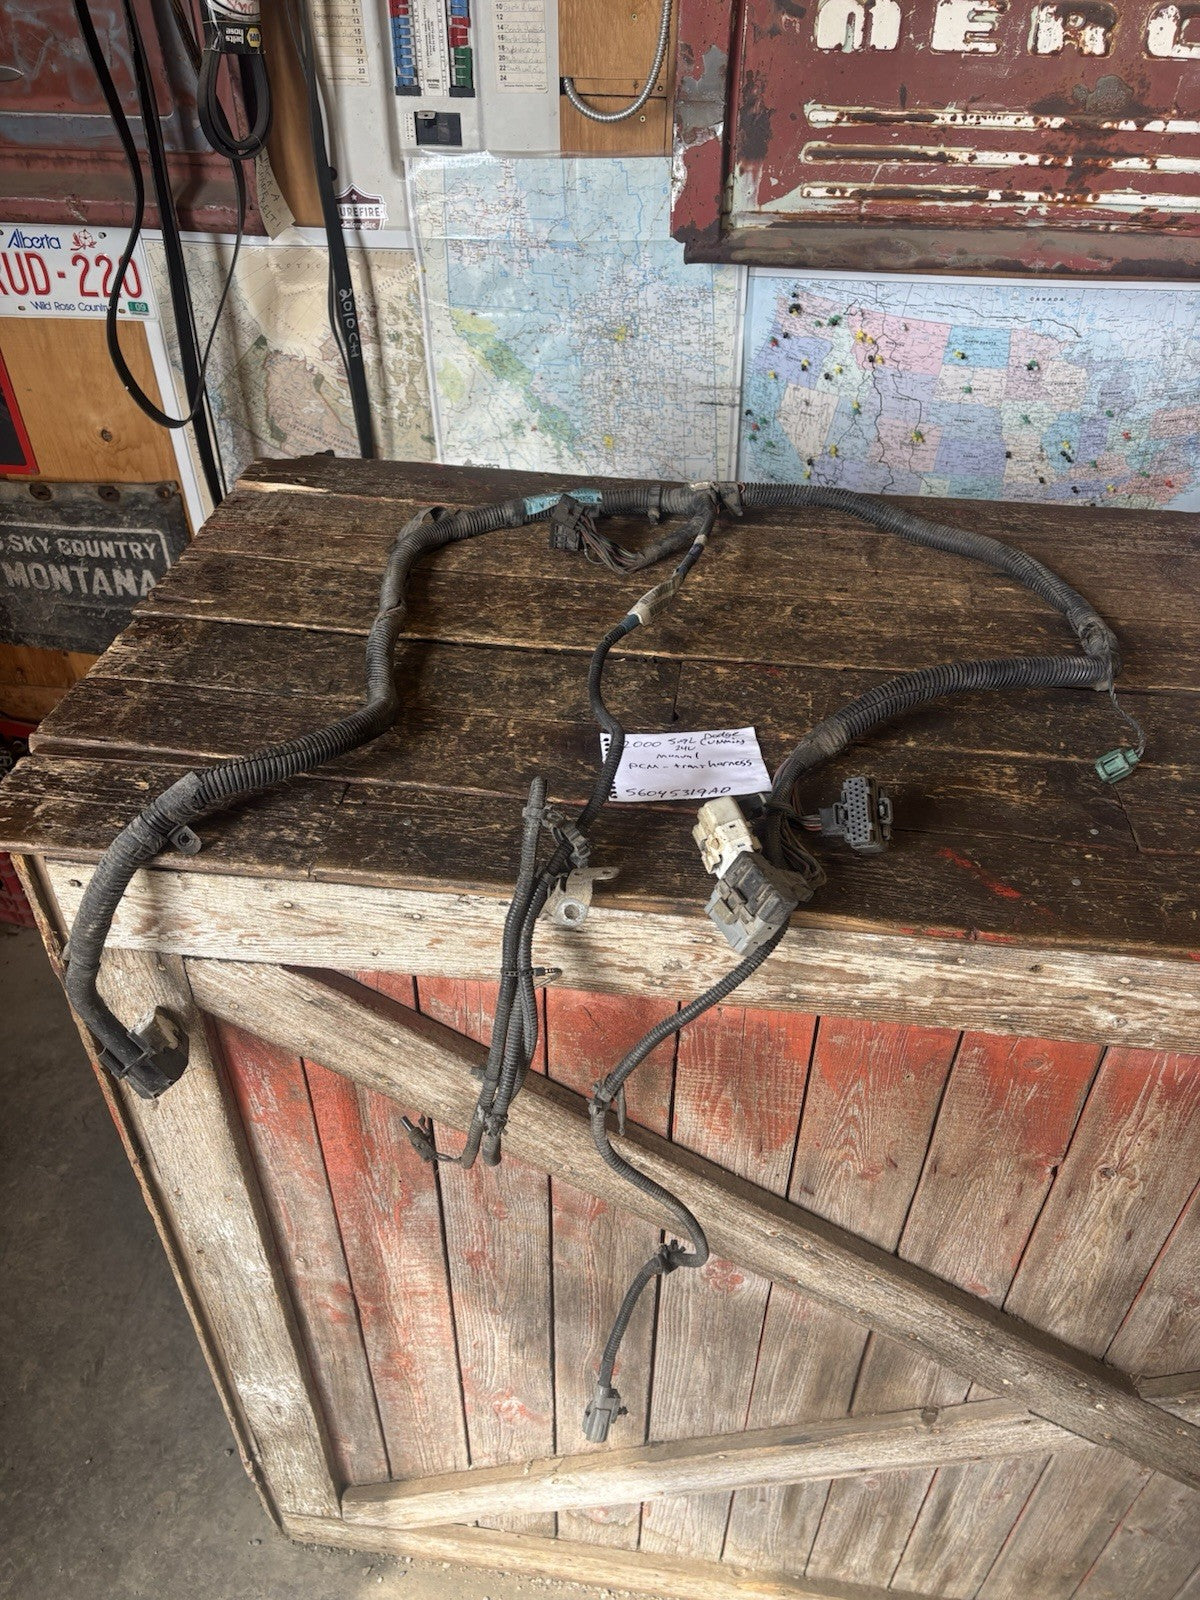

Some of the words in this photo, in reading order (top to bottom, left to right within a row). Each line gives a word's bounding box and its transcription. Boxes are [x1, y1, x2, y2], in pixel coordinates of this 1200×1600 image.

[339, 207, 381, 217] UREFIRE
[7, 228, 61, 249] Alberta
[0, 252, 142, 298] UD-220
[30, 301, 51, 311] Wild
[54, 301, 76, 311] Rose
[6, 534, 51, 554] SKY
[56, 538, 157, 561] COUNTRY
[1, 562, 157, 597] MONTANA
[708, 760, 753, 768] harness
